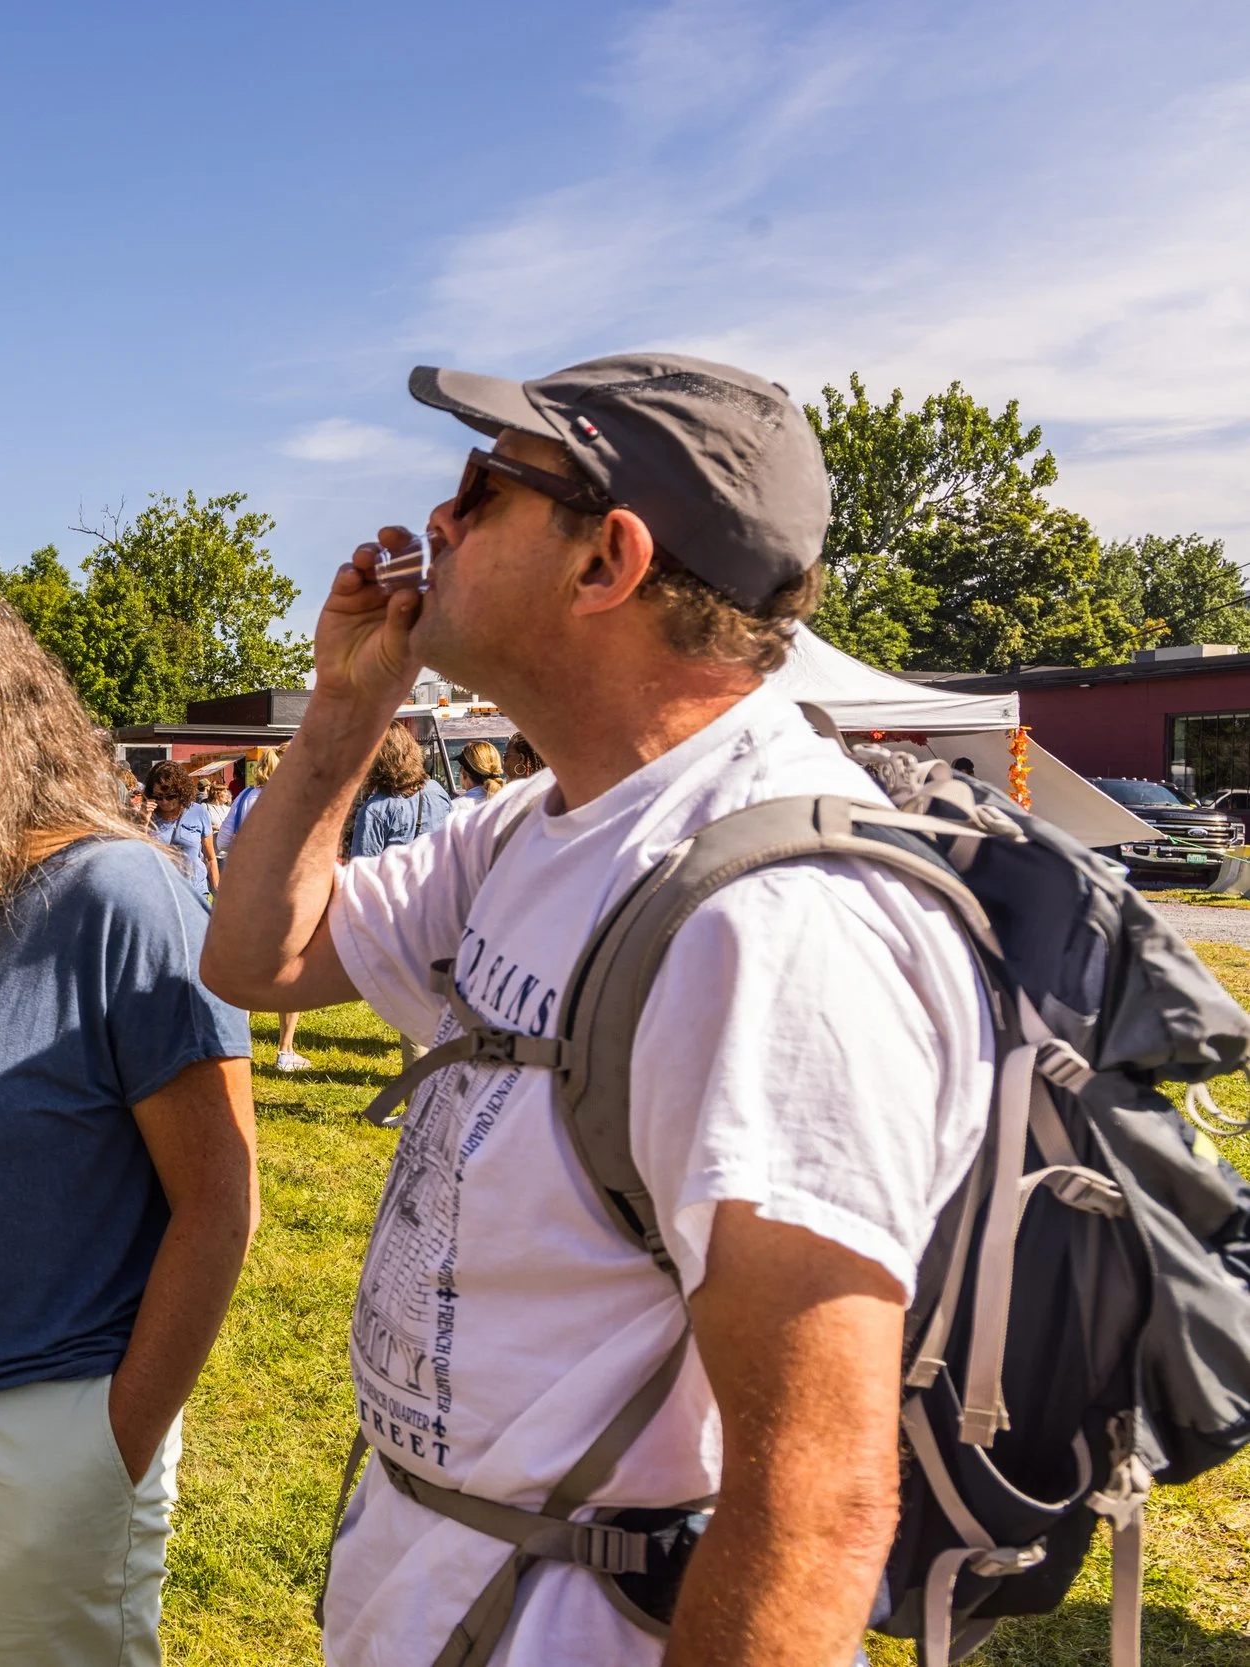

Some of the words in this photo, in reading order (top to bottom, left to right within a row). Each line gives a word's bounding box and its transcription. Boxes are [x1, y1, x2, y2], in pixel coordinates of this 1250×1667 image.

[485, 1065, 522, 1115] FRENCH
[434, 1303, 455, 1356] FRENCH
[431, 1356, 453, 1414] QUARTER
[360, 1399, 450, 1468] TREET
[387, 1397, 430, 1433] QUARTER
